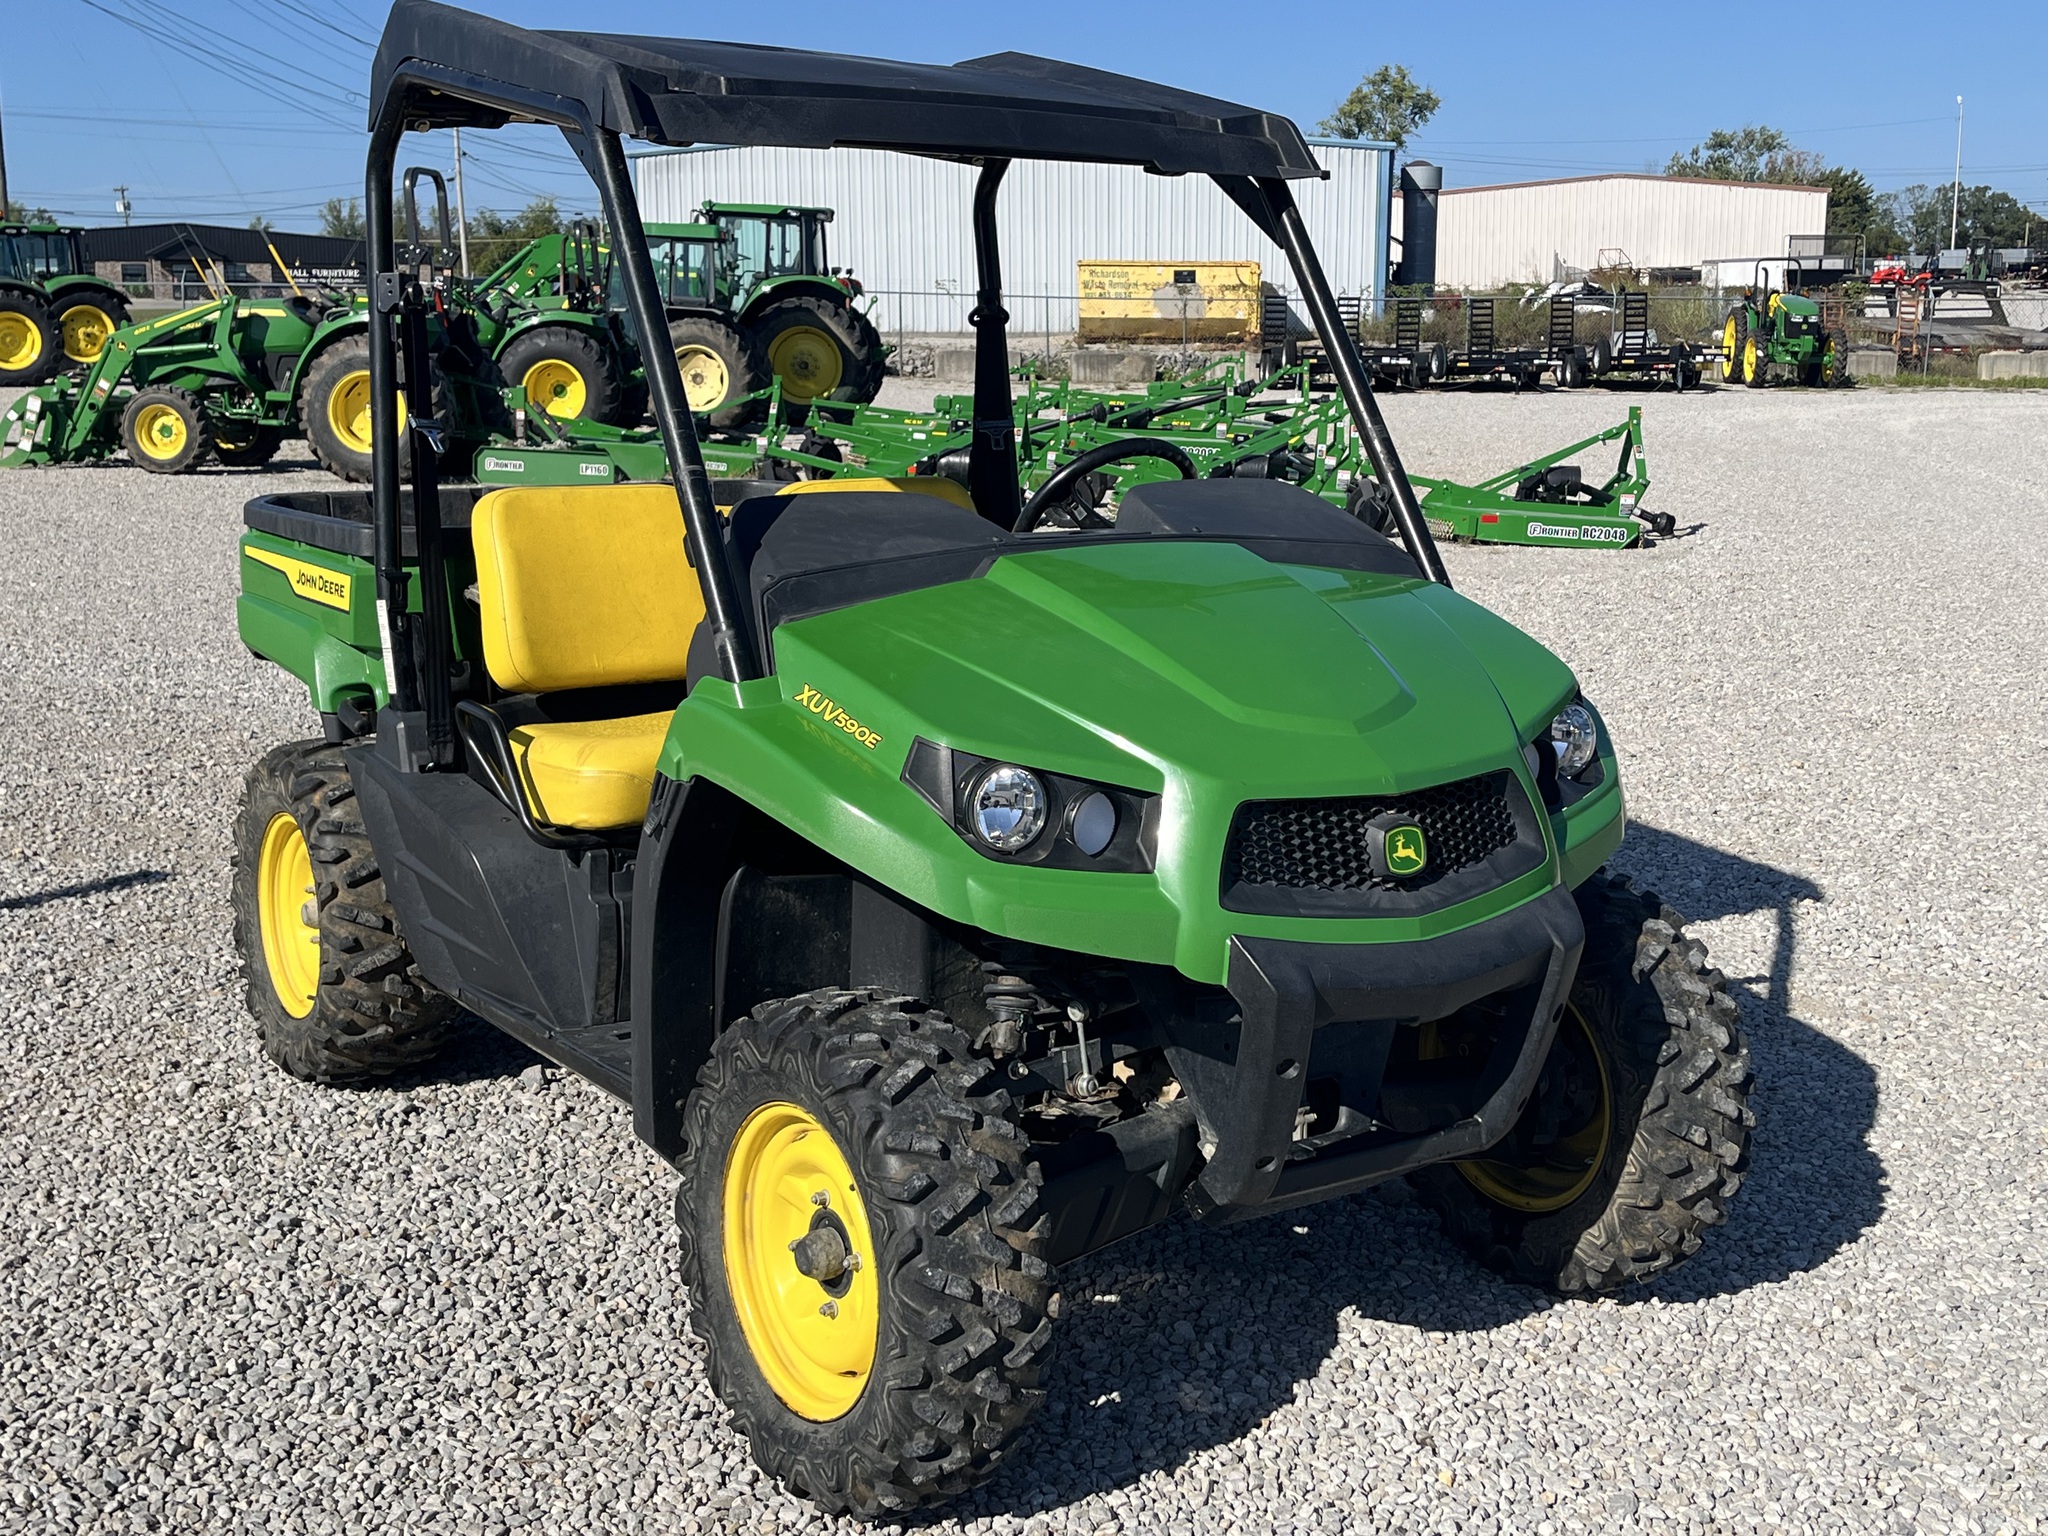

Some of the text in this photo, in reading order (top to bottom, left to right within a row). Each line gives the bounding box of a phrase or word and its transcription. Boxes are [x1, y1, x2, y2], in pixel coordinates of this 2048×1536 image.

[312, 269, 360, 277] FURNITURE
[1089, 269, 1129, 278] Richardson
[488, 460, 608, 474] FRONTIER LP1160
[1529, 524, 1626, 541] FRONTIER RC2048
[296, 569, 345, 598] JOHN DEERE
[793, 682, 884, 750] XUV590E
